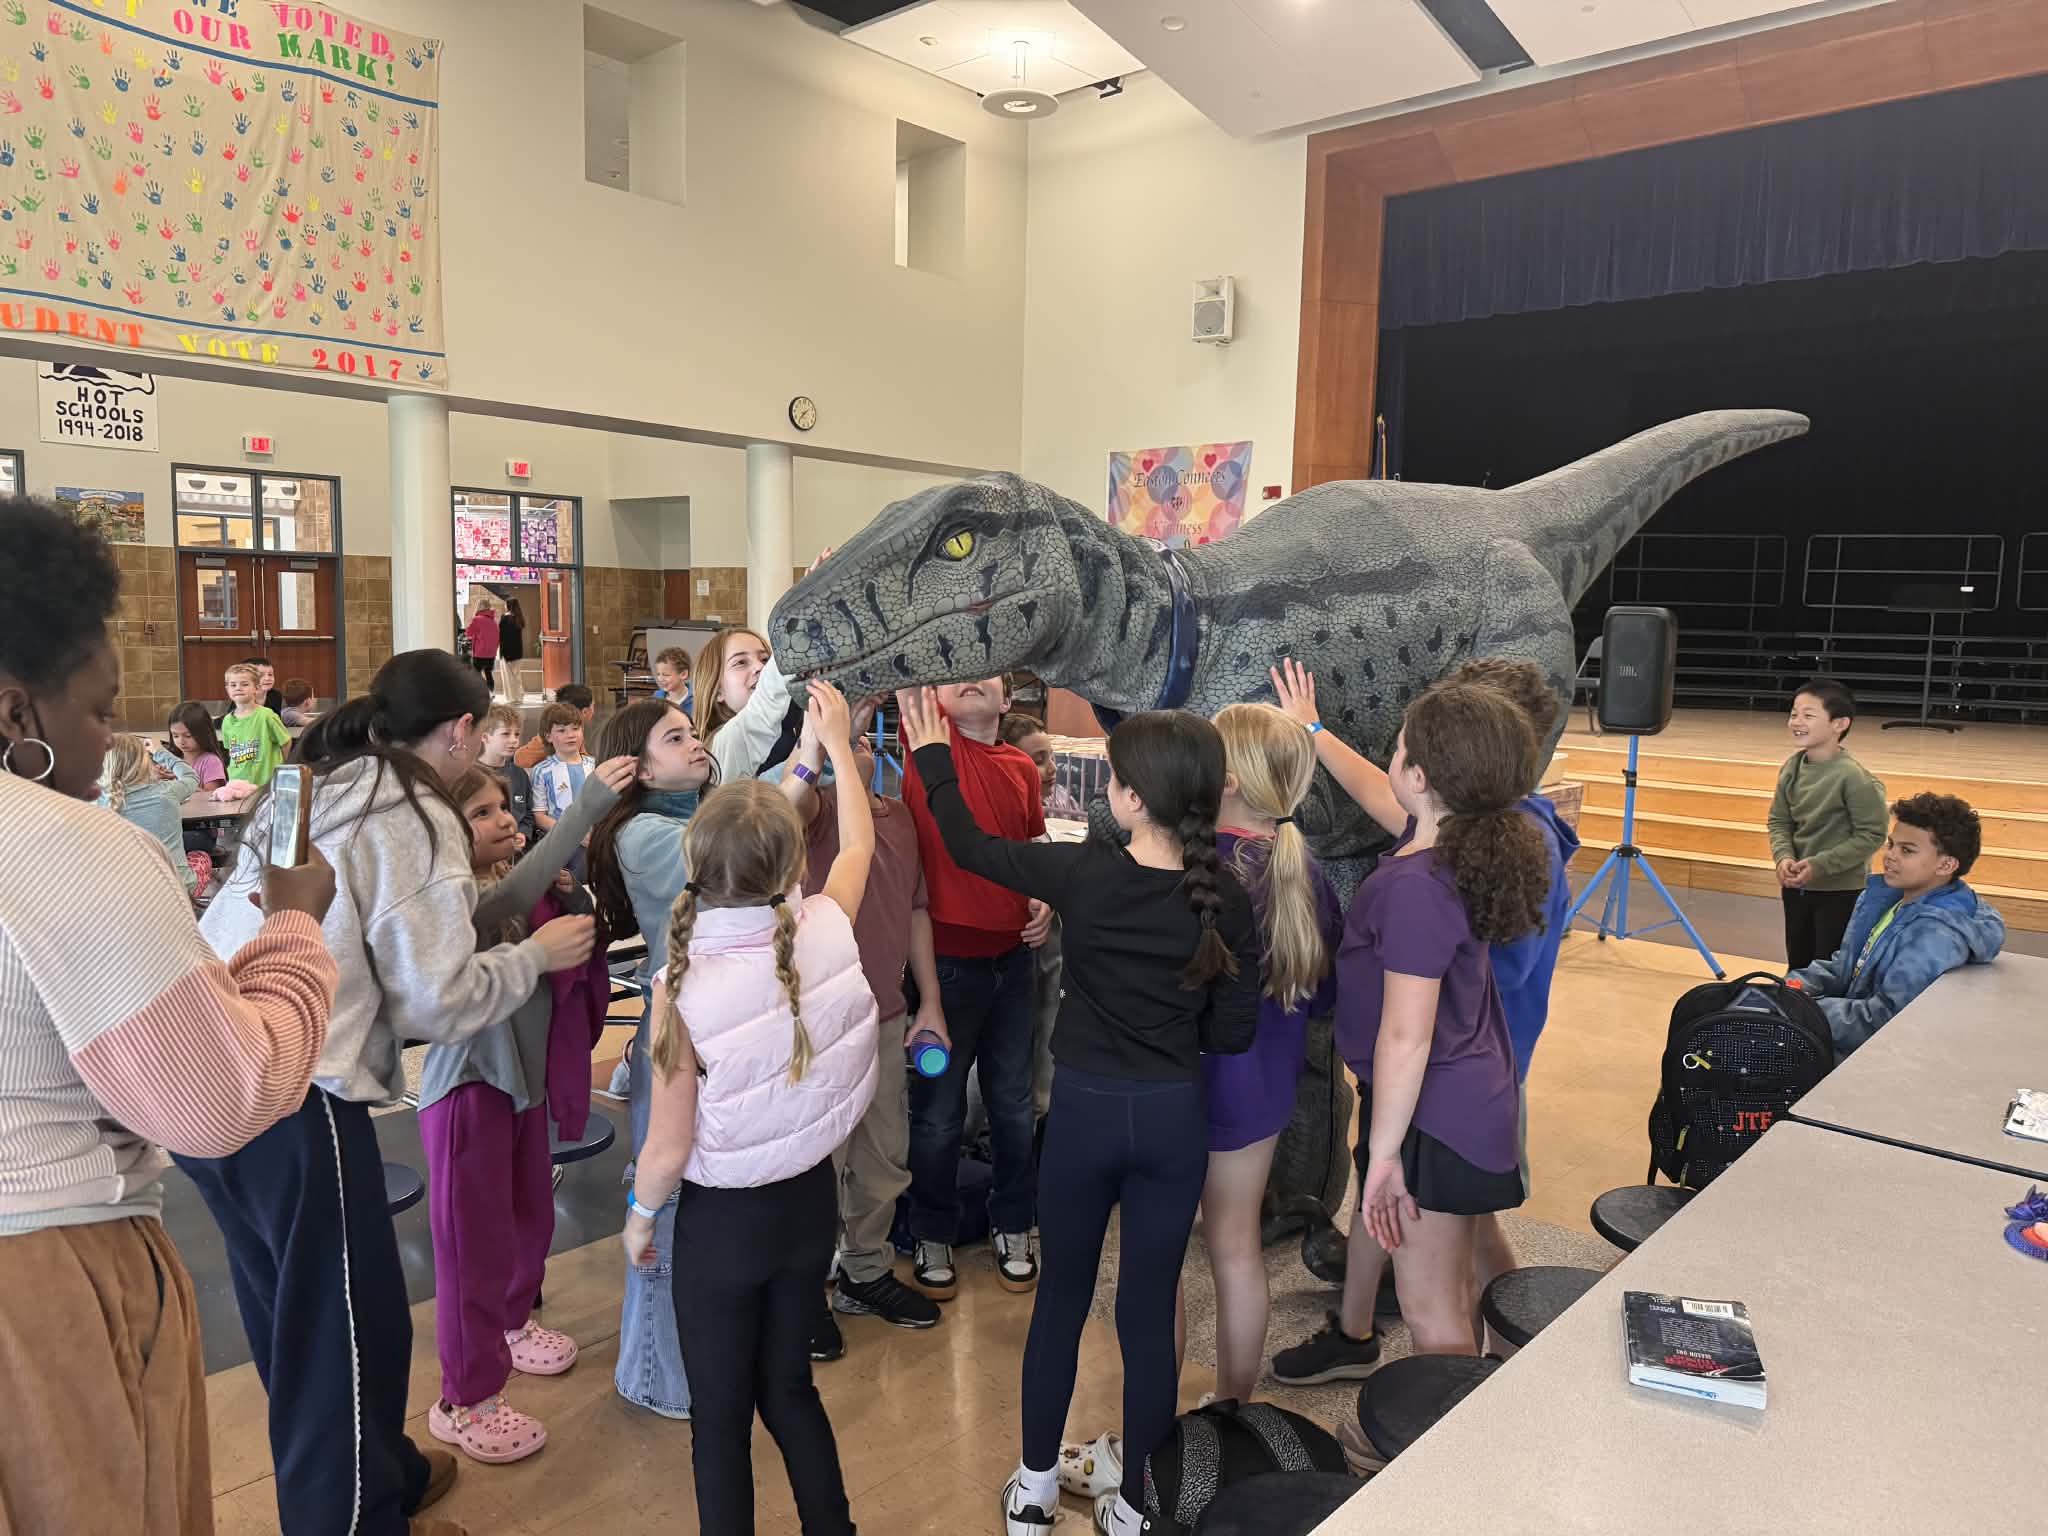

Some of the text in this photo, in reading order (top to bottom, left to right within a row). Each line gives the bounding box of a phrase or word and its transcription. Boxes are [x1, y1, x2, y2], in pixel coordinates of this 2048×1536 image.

[271, 4, 396, 62] VOTED,
[173, 9, 395, 86] OUR MARK!
[177, 335, 280, 366] VOTE
[312, 348, 403, 381] 2017
[77, 386, 124, 406] HOT
[56, 400, 144, 423] SCHOOLS
[58, 418, 144, 442] 1994-2018
[1732, 1111, 1774, 1131] JTF
